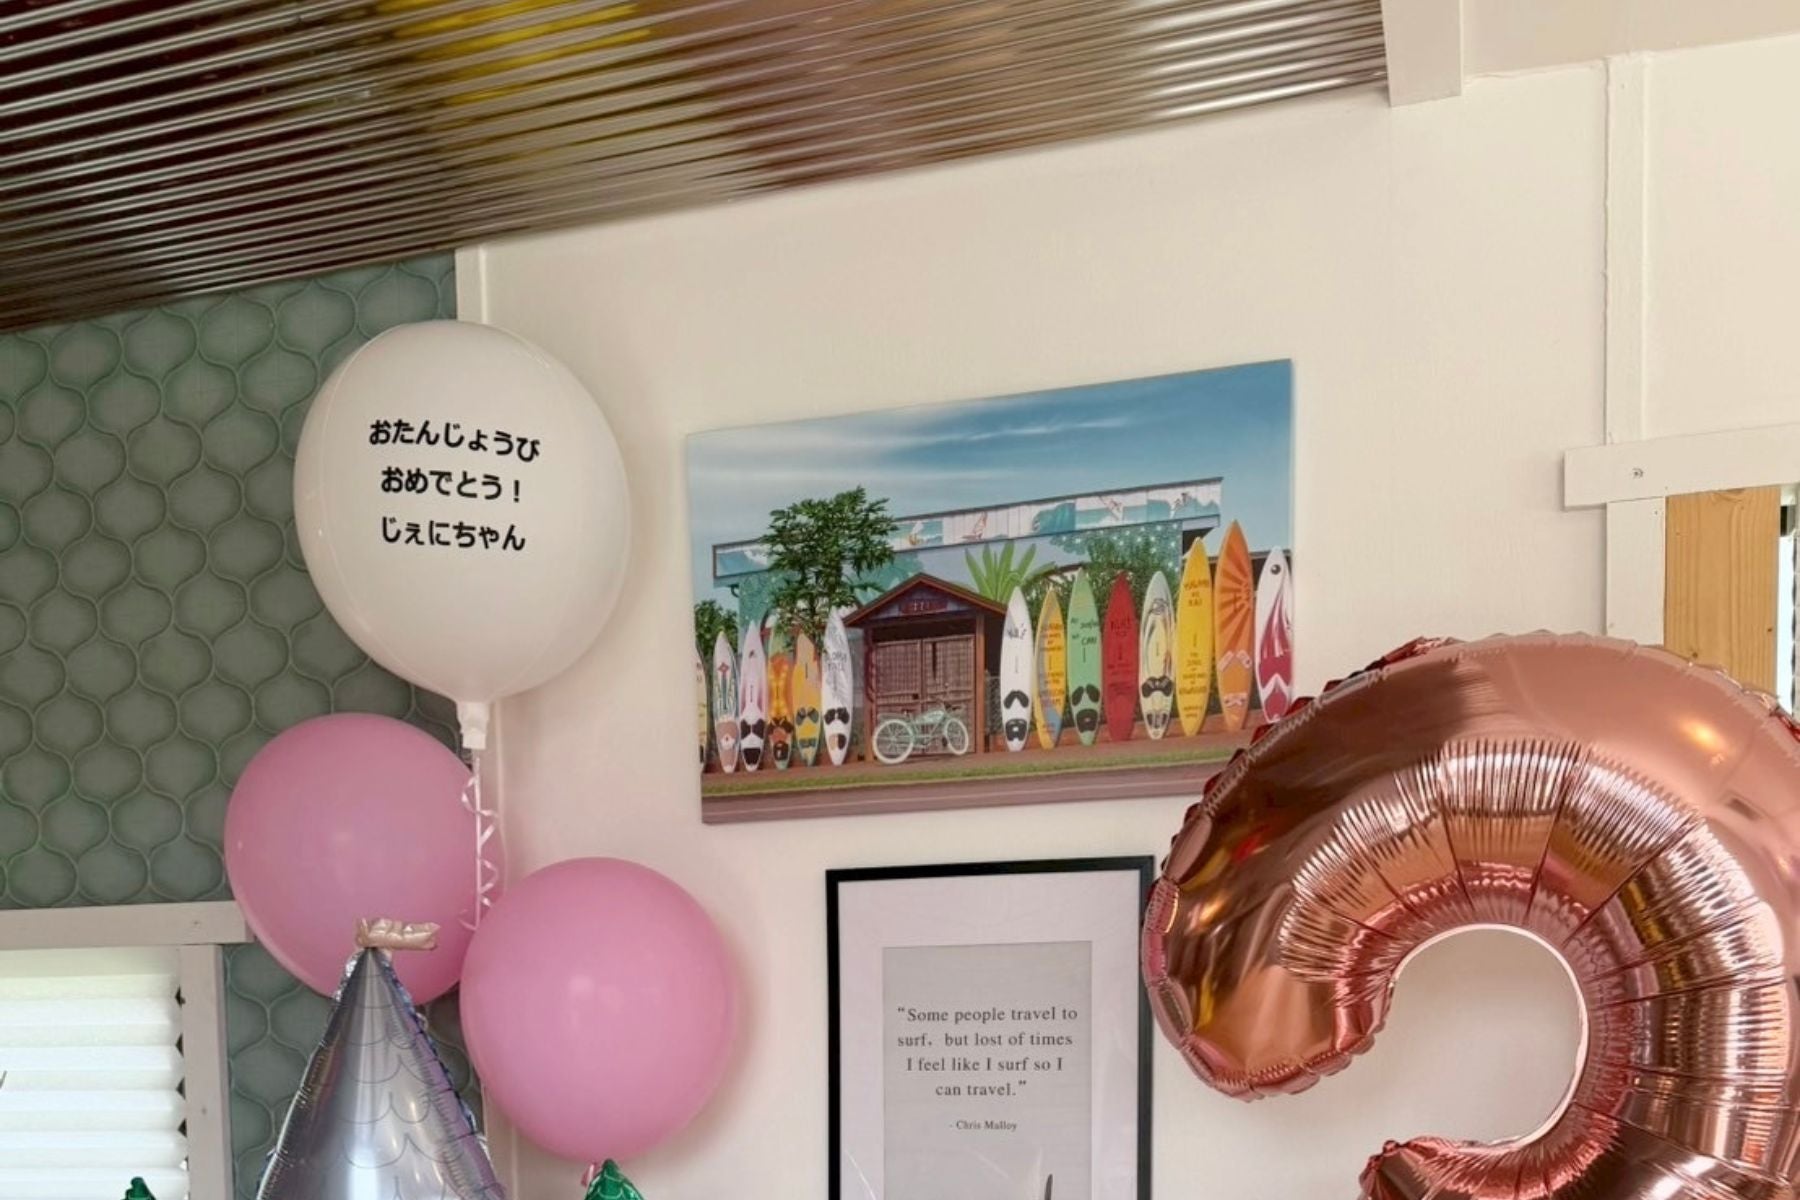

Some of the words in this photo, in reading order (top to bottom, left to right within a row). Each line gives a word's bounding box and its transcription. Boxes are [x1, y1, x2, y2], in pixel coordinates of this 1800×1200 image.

[369, 419, 540, 462] おたんじょうび
[381, 466, 520, 502] おめでとう！
[382, 516, 526, 551] じぇにちゃん
[897, 1006, 949, 1022] “Some
[954, 1008, 1006, 1024] people
[1011, 1006, 1056, 1021] travel
[1062, 1008, 1078, 1021] to
[944, 1032, 968, 1047] but
[975, 1032, 1002, 1046] lost
[1008, 1031, 1026, 1046] of
[1030, 1032, 1073, 1046] times
[906, 1057, 912, 1072] I
[918, 1057, 945, 1072] feel
[951, 1057, 980, 1072] like
[986, 1057, 992, 1071] I
[998, 1057, 1030, 1071] surf
[1033, 1061, 1051, 1071] so
[1056, 1057, 1063, 1071] I
[935, 1085, 962, 1096] can
[956, 1119, 981, 1130] Chris
